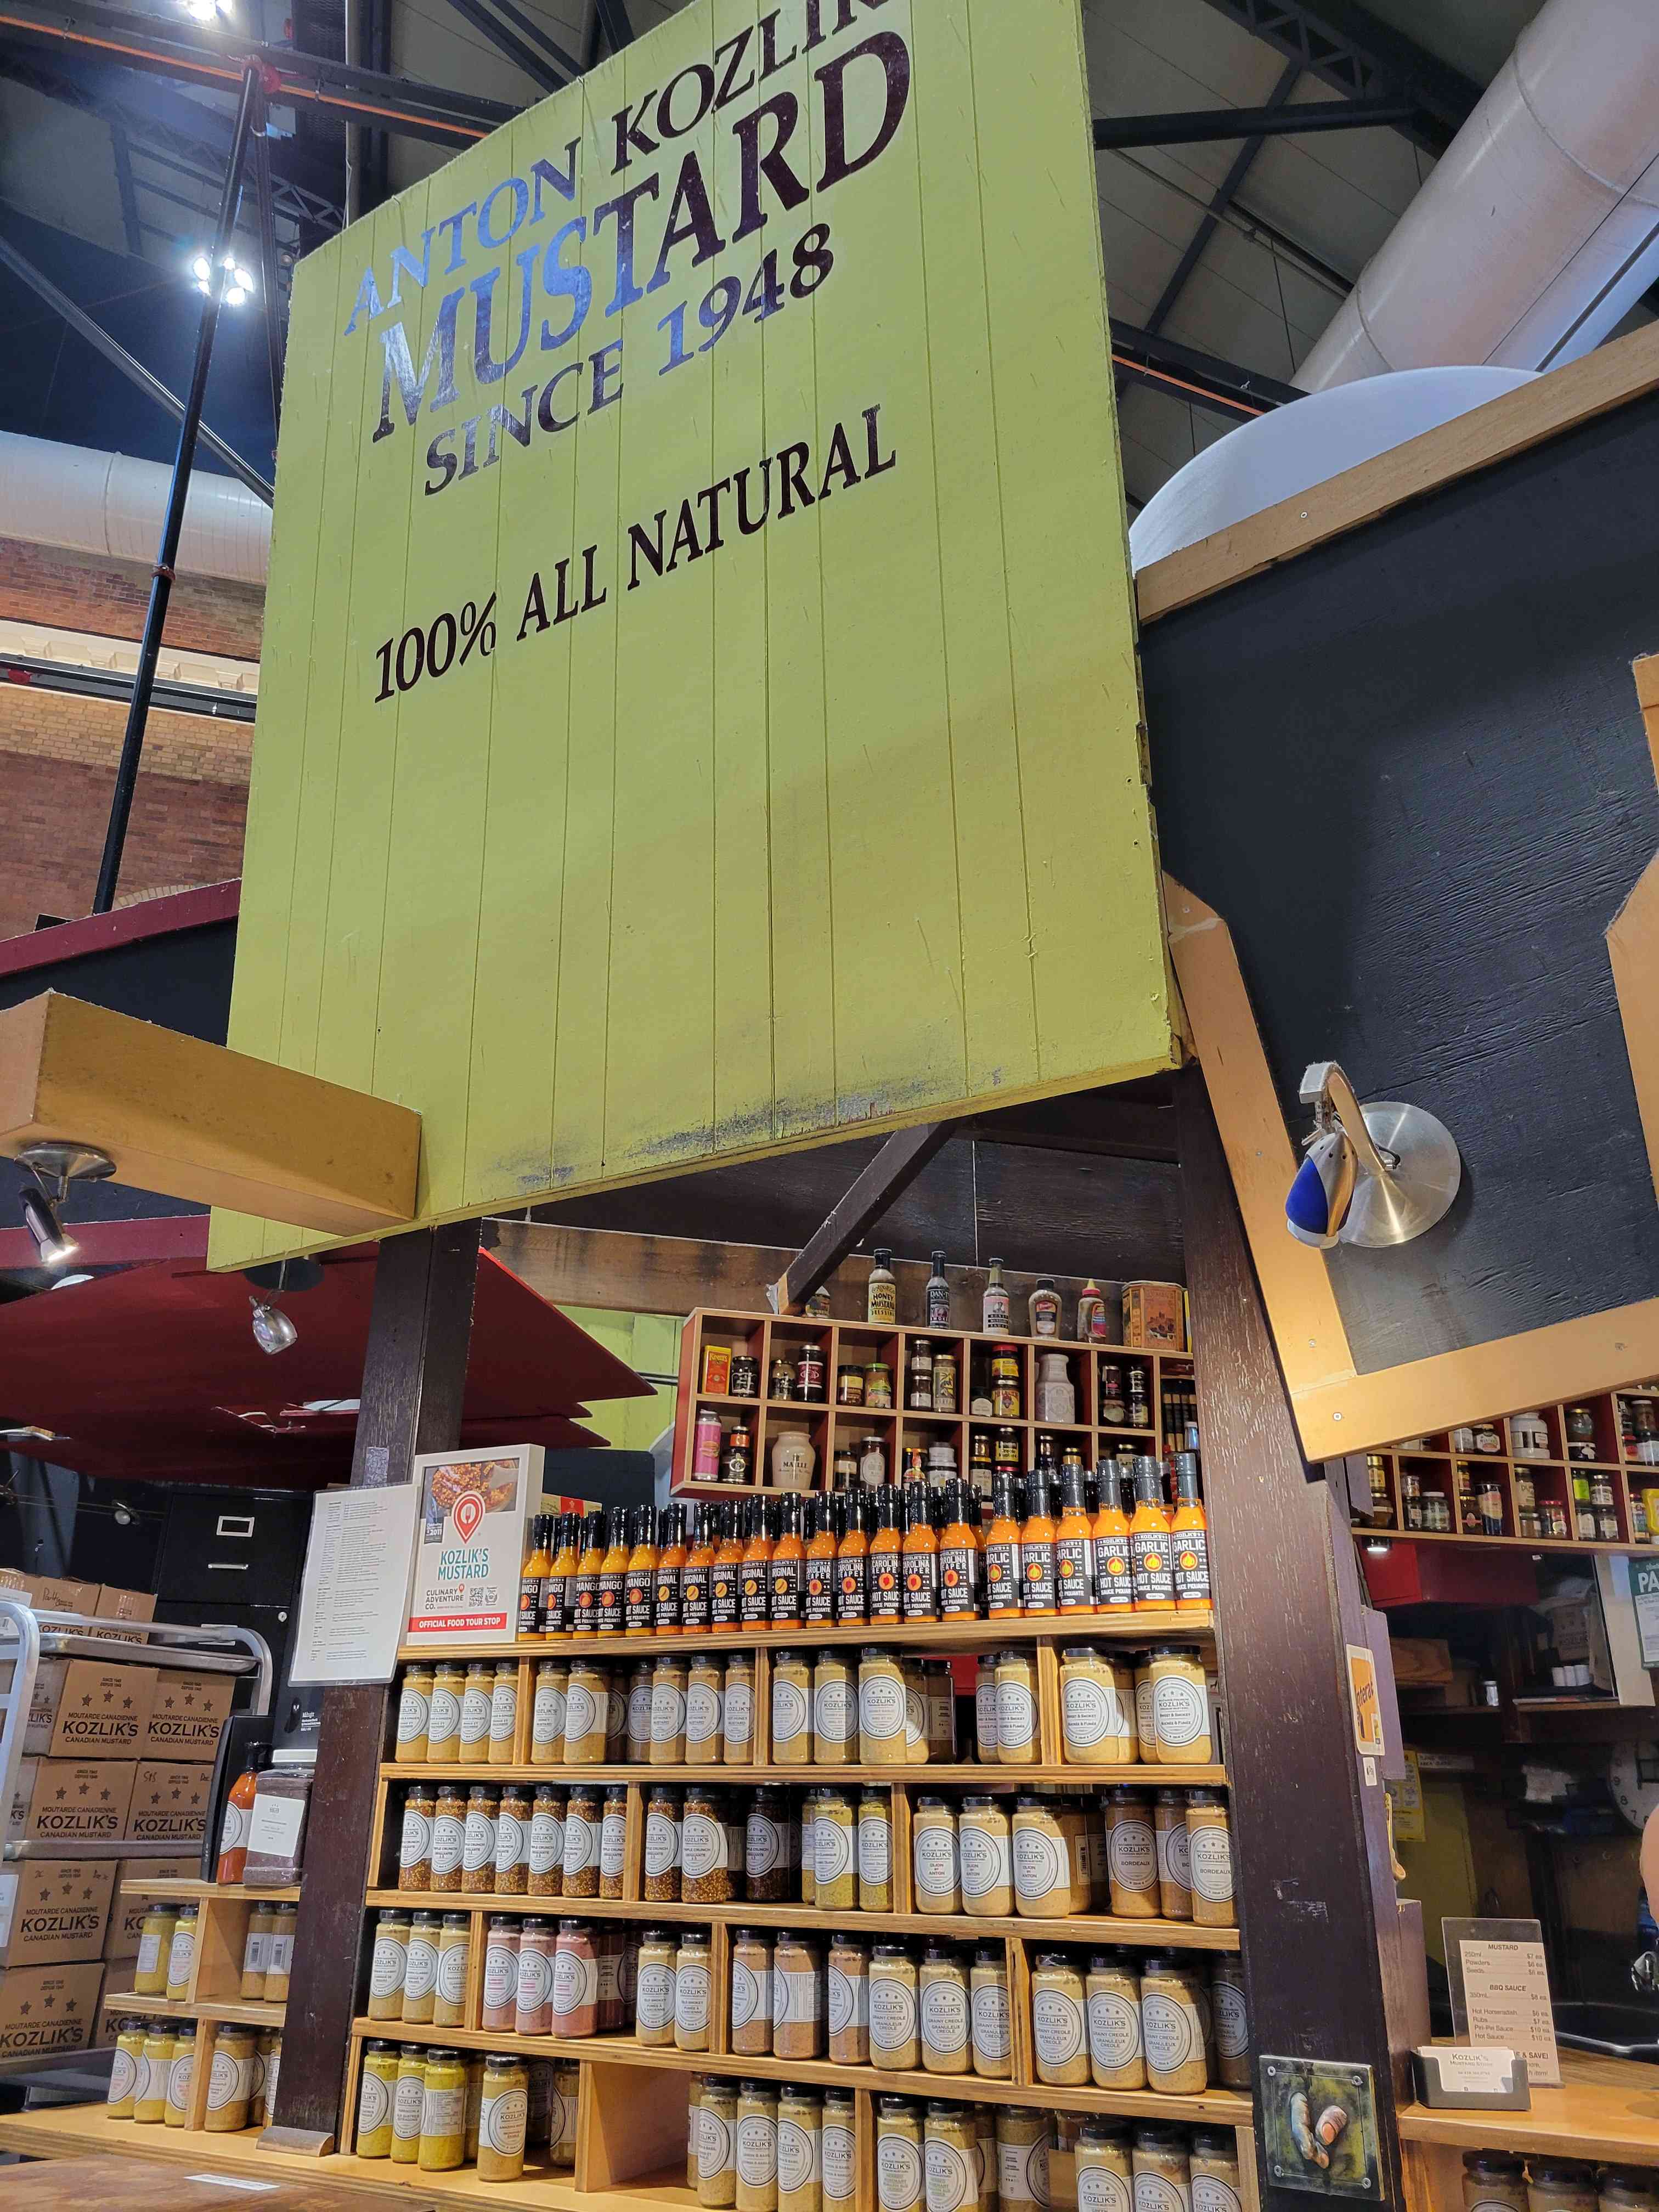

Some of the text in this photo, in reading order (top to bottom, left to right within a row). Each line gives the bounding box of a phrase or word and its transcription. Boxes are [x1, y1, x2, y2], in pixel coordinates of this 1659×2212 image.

[344, 137, 582, 336] ANTON
[373, 32, 910, 443] MUSTARD
[425, 223, 833, 495] SINCE 1948
[375, 404, 896, 702] 100% ALL NATURAL
[1135, 1542, 1169, 1553] GARLIC
[1173, 1539, 1205, 1551] GARLIC
[441, 1548, 489, 1565] KOZLIK'S
[1098, 1545, 1129, 1558] GARLIC
[438, 1564, 489, 1580] MUSTARD
[1187, 1571, 1209, 1582] SAUCE
[628, 1578, 650, 1587] MANGO
[1063, 1579, 1084, 1589] SAUCE
[1100, 1577, 1131, 1588] HOT SAUC
[1137, 1573, 1171, 1584] HOT SAUCE
[426, 1588, 458, 1596] CULINARY
[948, 1588, 968, 1598] SAUCE
[992, 1583, 1012, 1593] SAUCE
[1031, 1582, 1052, 1593] SAUCE
[426, 1594, 464, 1602] ADVENTURE
[747, 1596, 766, 1606] SAUCE
[777, 1595, 797, 1605] SAUCE
[812, 1597, 831, 1606] SAUCE
[846, 1595, 864, 1605] SAUCE
[911, 1592, 931, 1602] SAUCE
[661, 1602, 678, 1611] SAUCE
[690, 1602, 707, 1611] SAUCE
[718, 1599, 736, 1608] SAUCE
[604, 1608, 621, 1617] SAUCE
[632, 1605, 650, 1614] SAUCE
[419, 1617, 501, 1628] OFFICIAL FOOD TOUR STOP
[183, 1716, 218, 1724] CANADIENNE
[62, 1721, 139, 1737] KOZLIK'S
[148, 1722, 219, 1738] KOZLIK'S
[1620, 1795, 1628, 1805] 8
[1630, 1810, 1637, 1821] 7
[37, 1815, 119, 1830] KOZLIK'S
[133, 1818, 207, 1832] KOZLIK'S
[20, 1914, 99, 1933] KOZLIK'S
[5, 2019, 83, 2030] MOUTARDE CANADIENNE
[0, 2026, 83, 2048] KOZLIK'S
[2, 2045, 76, 2058] CANADIAN MUSTARD
[1138, 2200, 1169, 2210] KOZLIK'S
